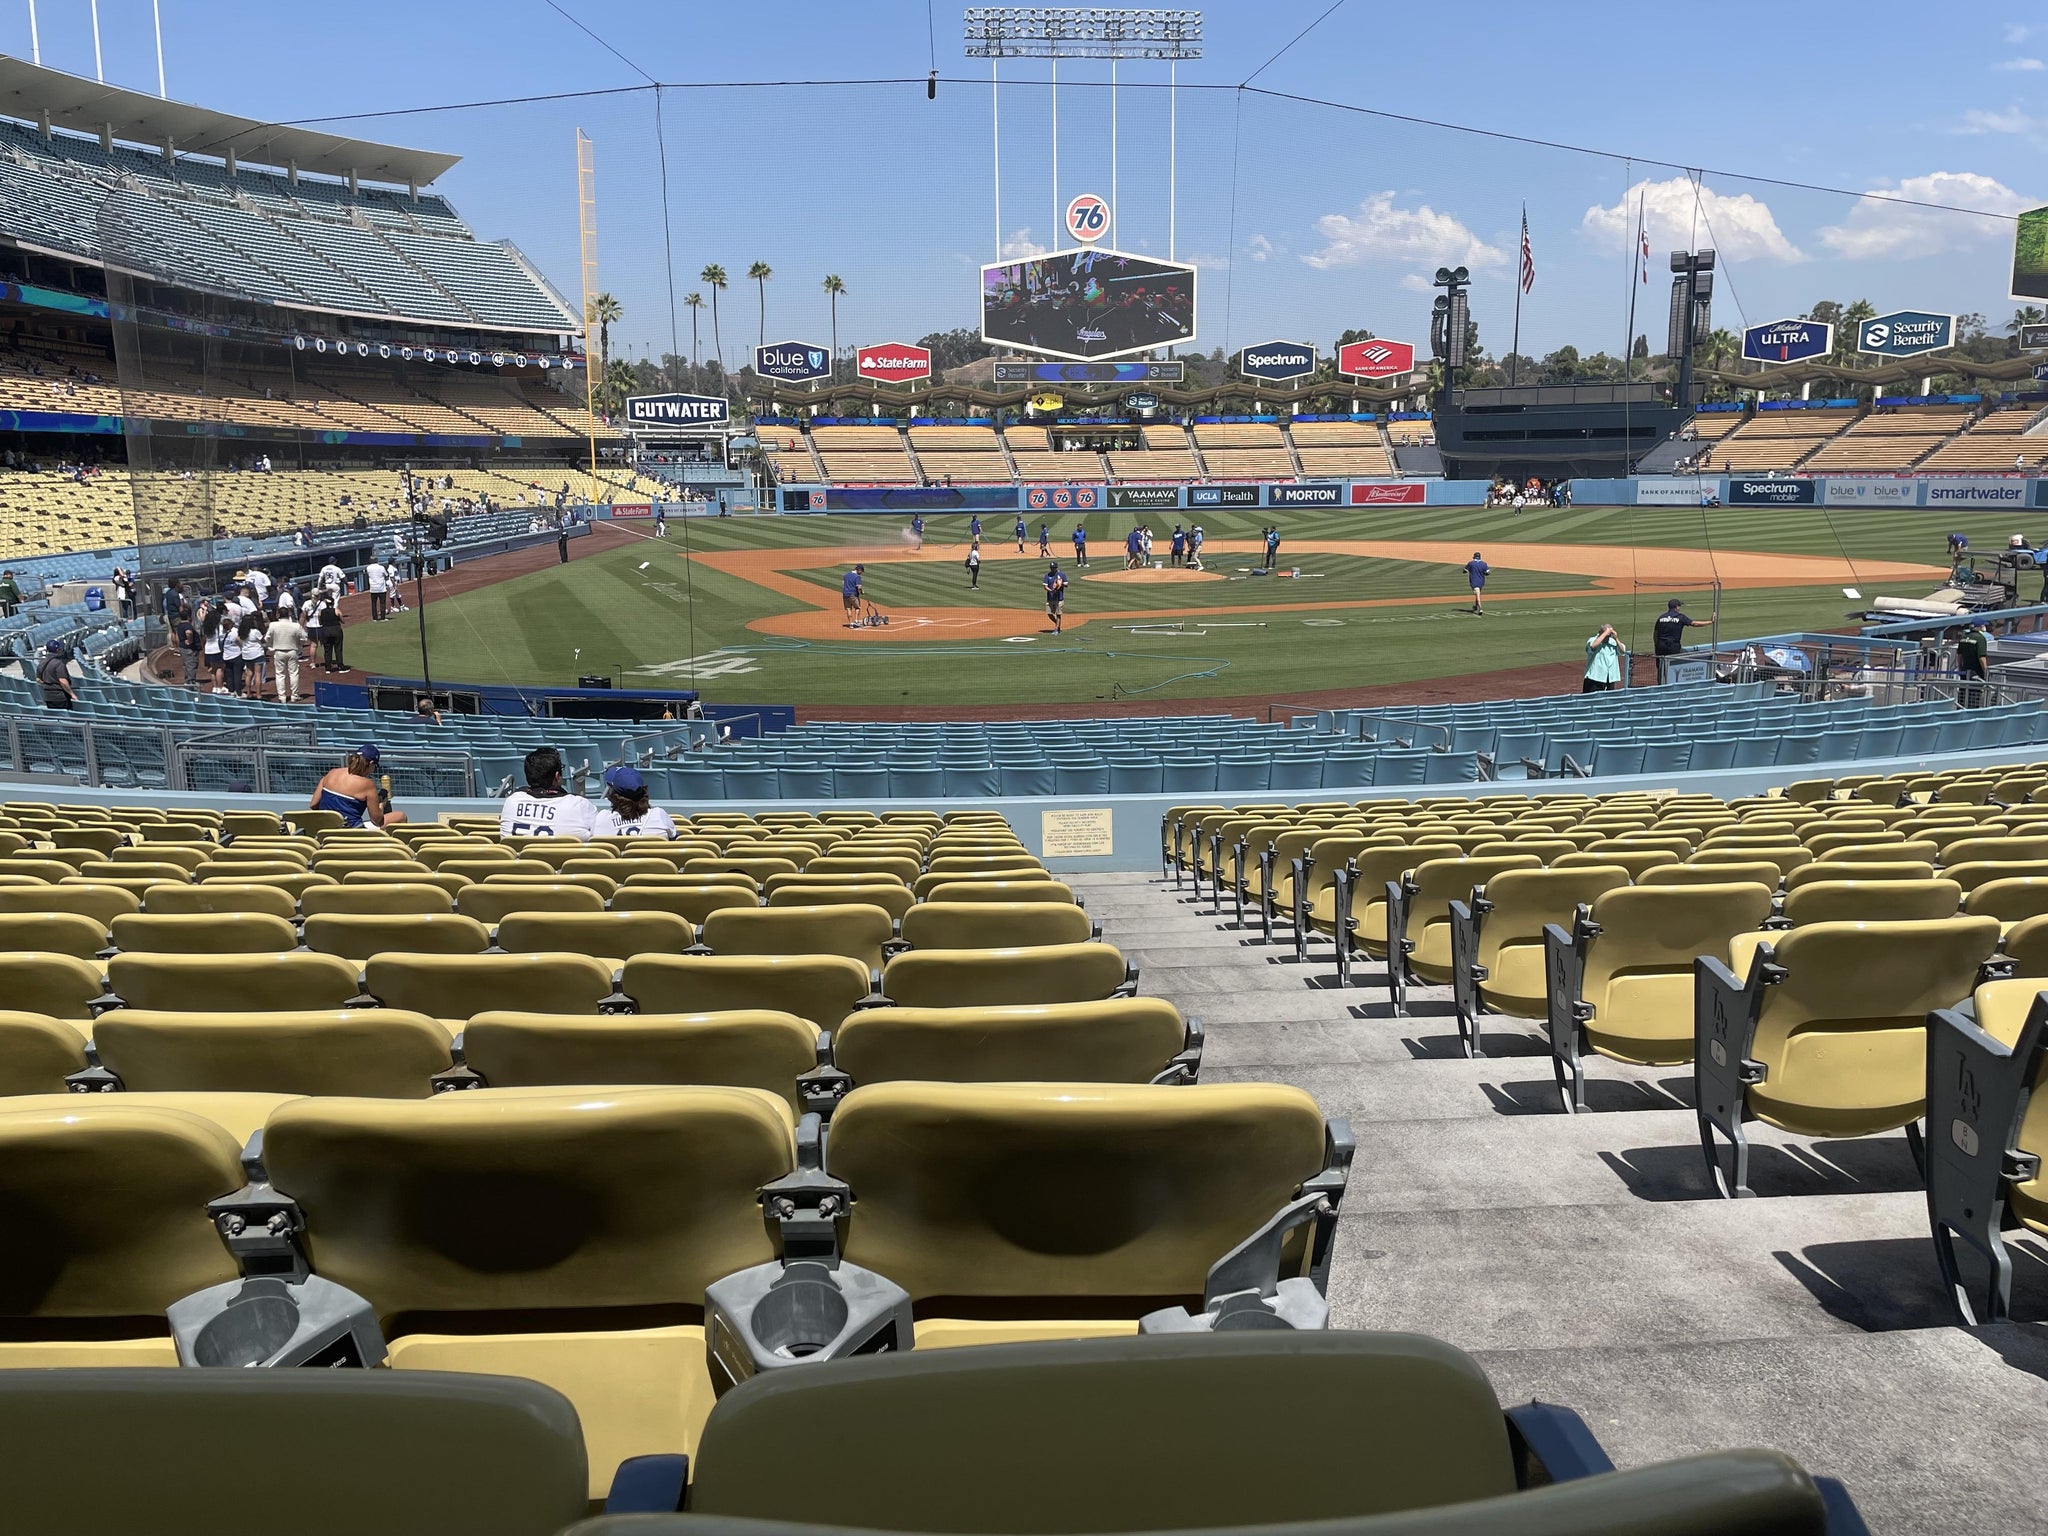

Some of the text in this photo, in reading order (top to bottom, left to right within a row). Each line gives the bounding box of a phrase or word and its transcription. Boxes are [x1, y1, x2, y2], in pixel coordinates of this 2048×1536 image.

[1072, 204, 1104, 230] 76
[1893, 320, 1944, 335] Security
[1761, 331, 1810, 345] ULTRA
[1892, 333, 1936, 346] Benefit
[762, 348, 804, 366] blue
[1247, 353, 1305, 369] Spectrum
[769, 365, 809, 374] california
[634, 402, 721, 418] CUTWATER
[1743, 482, 1797, 496] Spectrum
[1830, 485, 1855, 496] blue
[1874, 485, 1899, 496] blue
[1931, 485, 2023, 500] smartwater
[812, 495, 824, 505] 76
[1031, 493, 1045, 505] 76
[1055, 493, 1069, 505] 76
[1078, 493, 1092, 504] 76
[1196, 491, 1254, 501] UCLA Health
[1286, 490, 1336, 501] MORTON
[1769, 493, 1797, 502] mobile
[516, 803, 557, 820] BETTS
